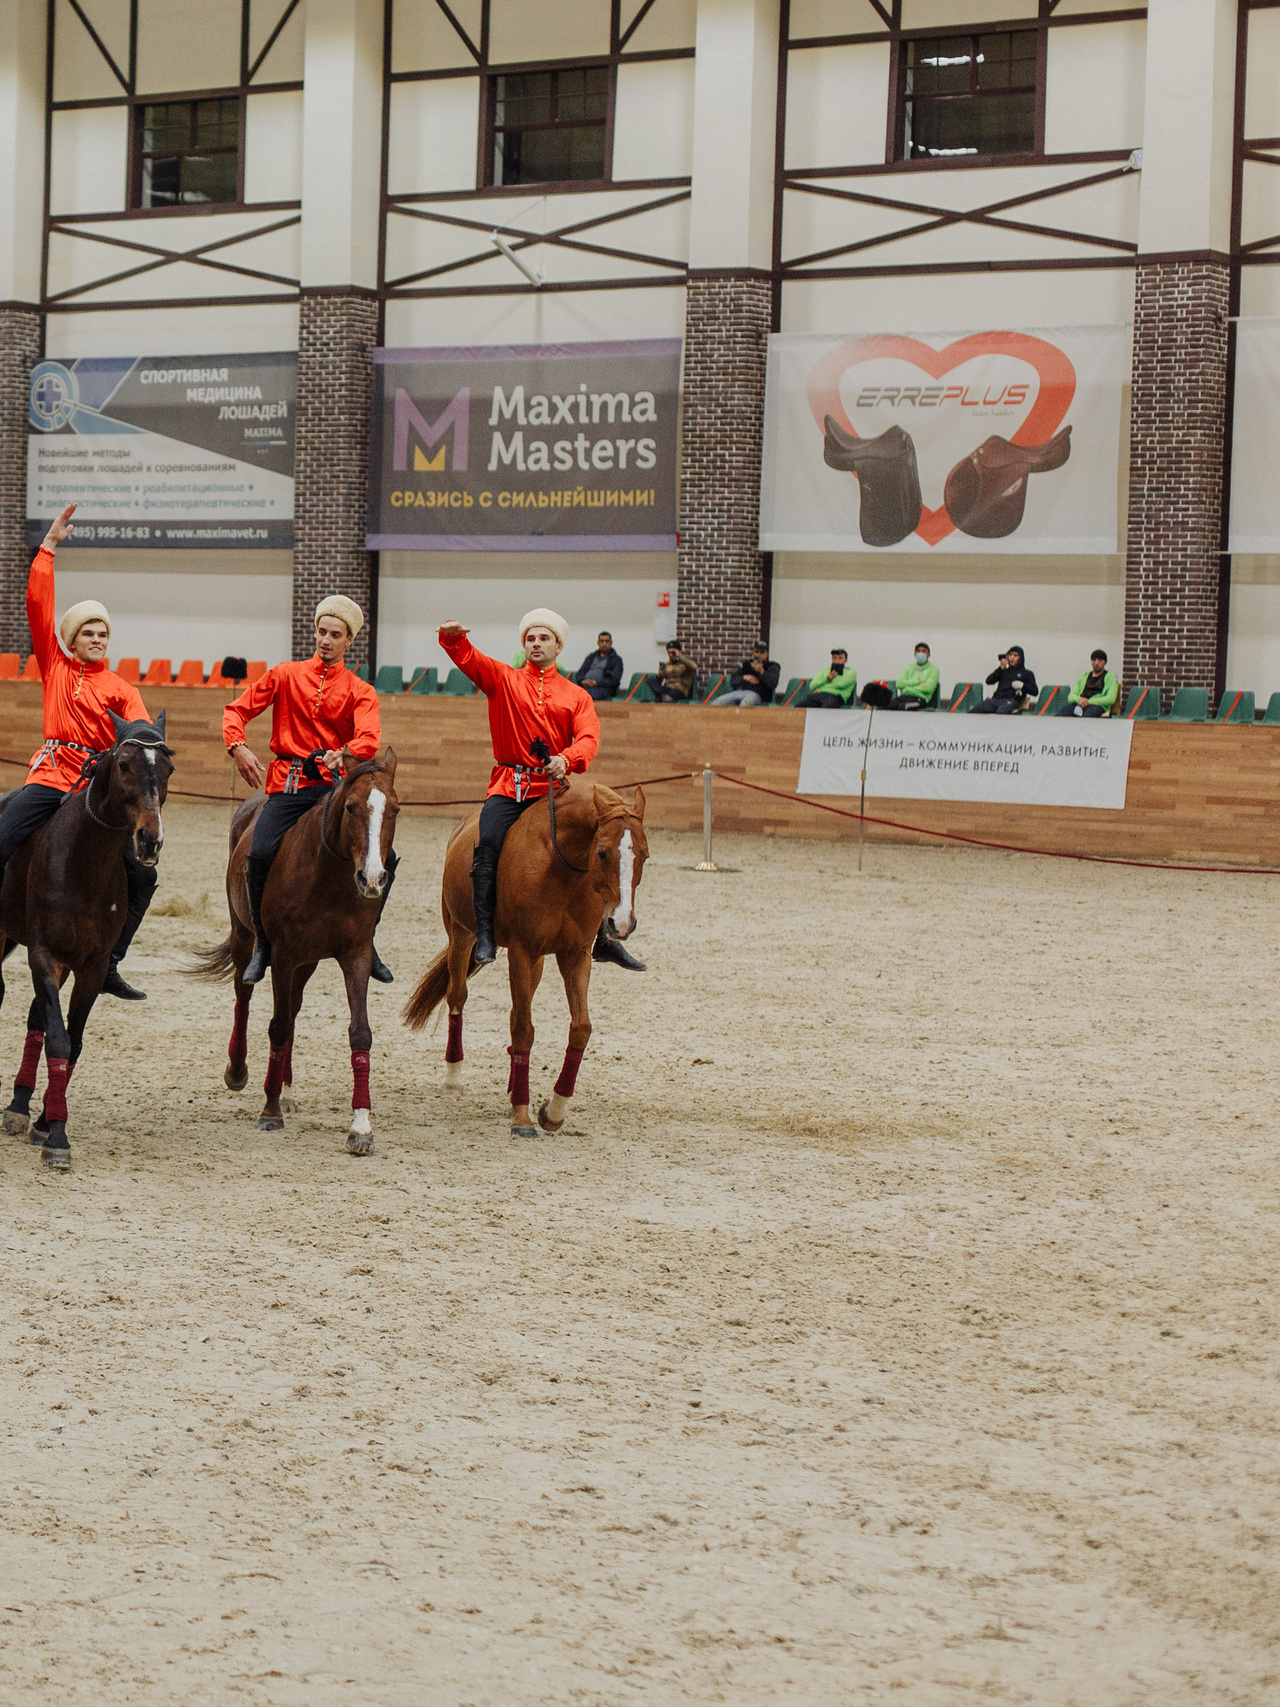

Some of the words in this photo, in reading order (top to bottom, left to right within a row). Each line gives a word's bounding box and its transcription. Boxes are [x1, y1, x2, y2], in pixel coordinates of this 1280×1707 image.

[140, 368, 228, 384] СПОРТИВНАЯ
[186, 386, 263, 403] МЕДИЦИНА
[856, 384, 1030, 408] ERREPLUS
[218, 401, 288, 421] ЛОШАДЕЙ
[488, 383, 657, 426] Maxima
[244, 427, 283, 438] MAXIMA
[38, 447, 89, 458] Новейшие
[92, 449, 131, 459] методы
[488, 431, 657, 472] Masters
[37, 464, 95, 474] подготовки
[97, 461, 143, 474] лошадей
[155, 463, 236, 475] соревнованиям
[390, 490, 473, 508] СРАЗИСЬ
[479, 491, 494, 508] С
[498, 486, 656, 508] СИЛЬНЕЙШИМИ!
[97, 526, 150, 539] 995-16-83
[166, 526, 268, 540] www.maximavet.ru
[823, 735, 854, 749] ЦЕЛЬ
[857, 737, 904, 750] ЖИЗНИ
[918, 740, 1037, 757] КОММУНИКАЦИИ,
[1040, 745, 1110, 760] РАЗВИТИЕ,
[899, 757, 969, 772] ДВИЖЕНИЕ
[973, 760, 1020, 775] ВПЕРЕД
